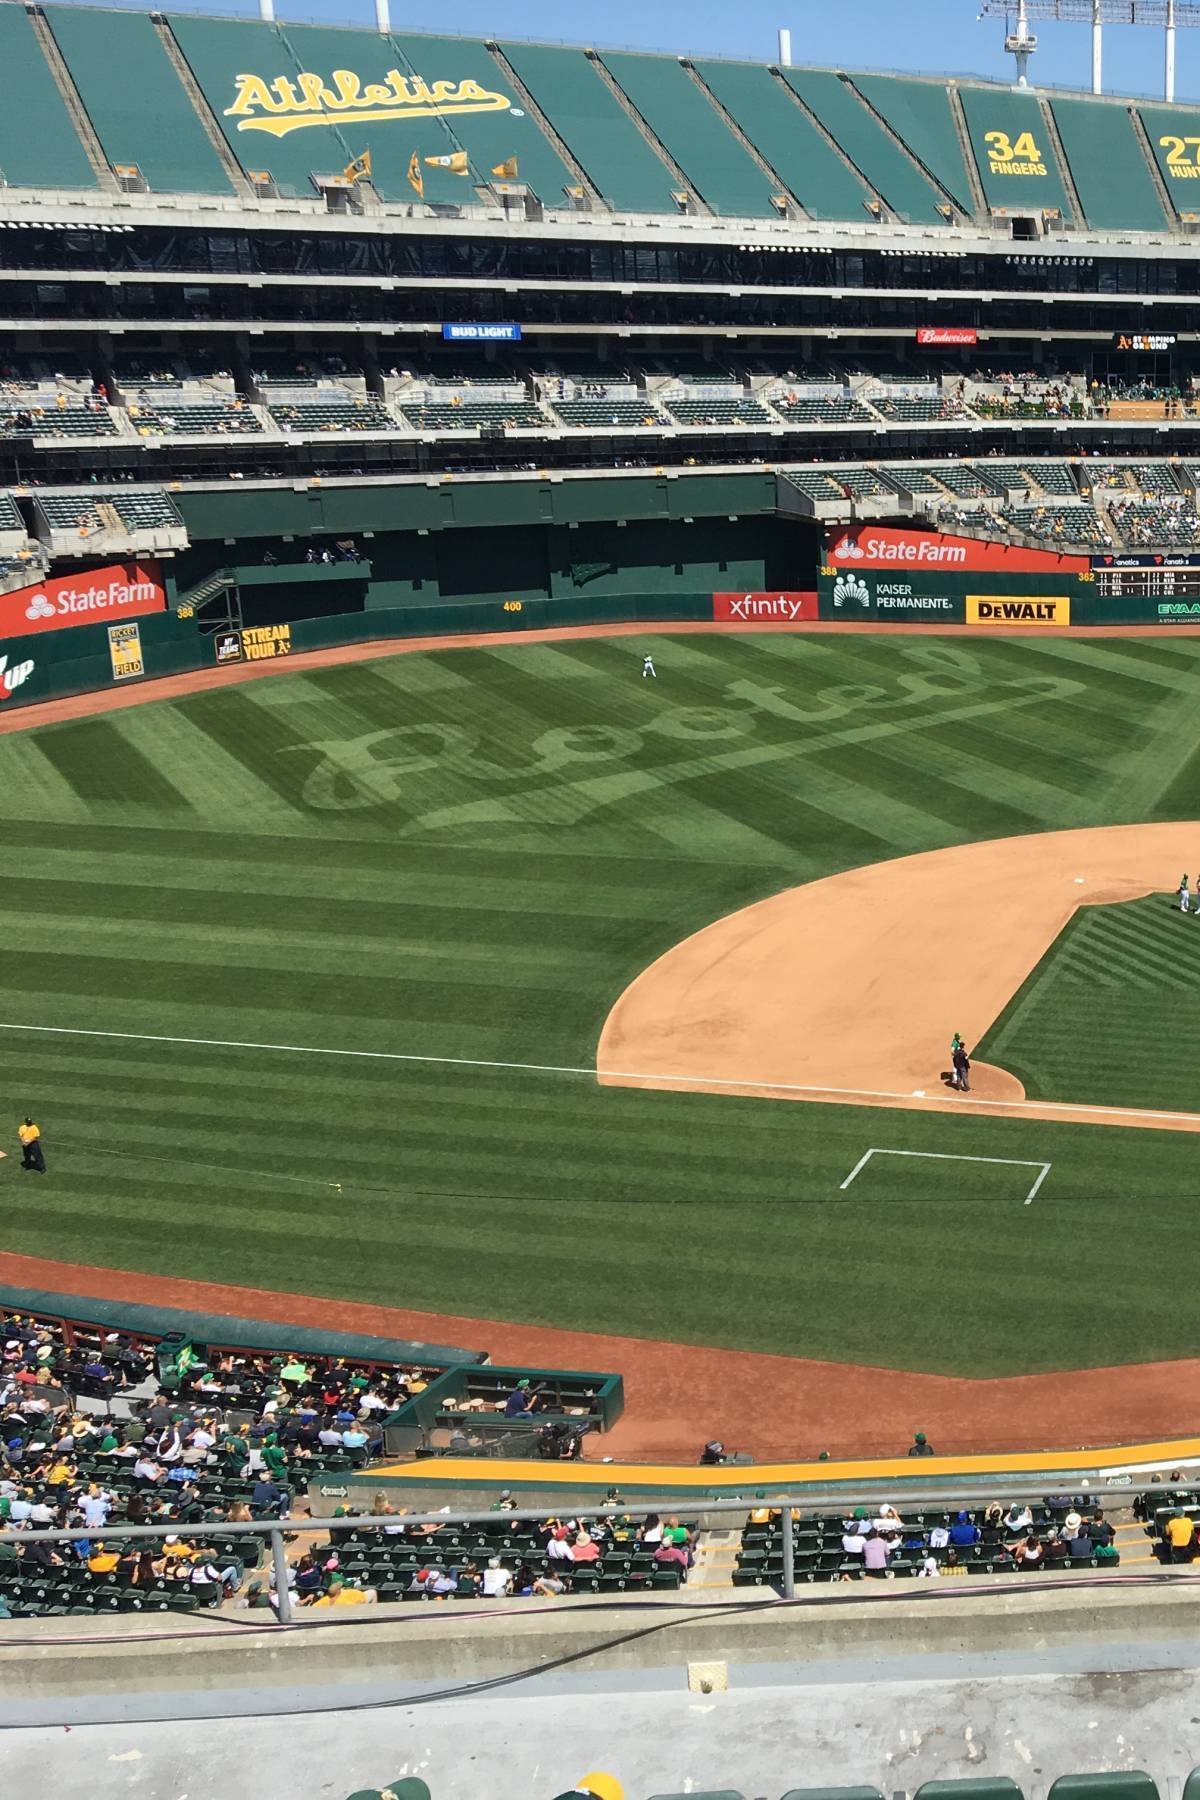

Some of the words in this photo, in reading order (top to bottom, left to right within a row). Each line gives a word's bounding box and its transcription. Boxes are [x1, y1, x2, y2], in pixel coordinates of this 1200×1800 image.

[223, 69, 511, 117] Athletics
[984, 131, 1041, 162] 34
[990, 161, 1047, 176] FINGERS
[451, 326, 477, 337] BUD
[477, 327, 513, 337] LIGHT
[920, 330, 975, 343] Budweiser
[821, 567, 837, 577] 388
[1079, 573, 1095, 582] 362
[877, 584, 912, 595] KAISER
[503, 601, 522, 611] 400
[730, 595, 802, 619] xfinity
[177, 607, 194, 619] 388
[112, 628, 136, 638] RICKEY
[242, 624, 290, 645] STREAM
[219, 644, 239, 655] TEAMS
[243, 641, 275, 660] YOUR
[0, 655, 35, 690] UP
[115, 662, 141, 675] FIELD
